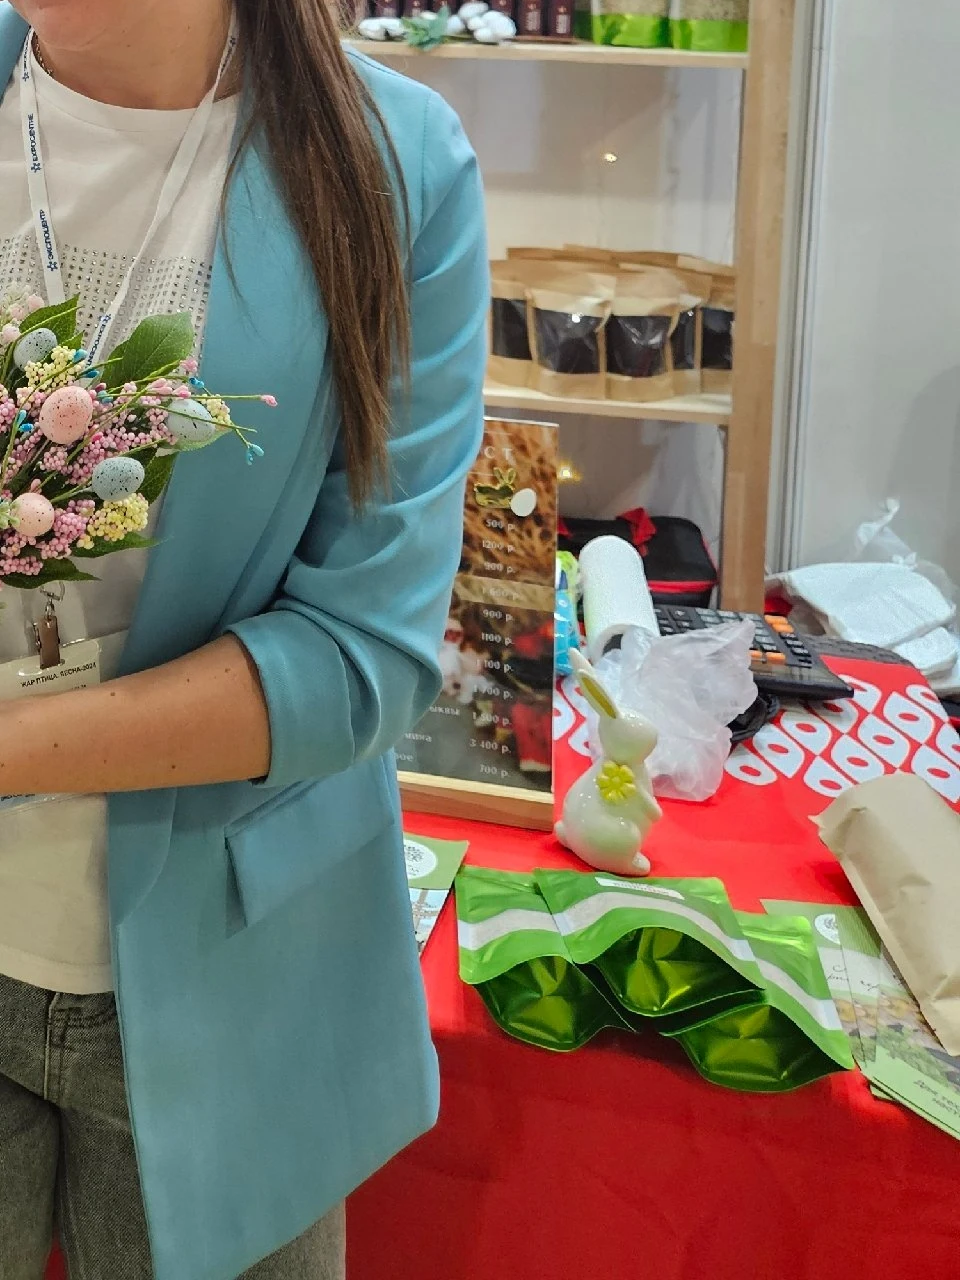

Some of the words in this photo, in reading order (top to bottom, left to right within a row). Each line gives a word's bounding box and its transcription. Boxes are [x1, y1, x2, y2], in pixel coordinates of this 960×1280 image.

[28, 113, 39, 162] EXPOCENTRE
[39, 209, 54, 261] ЭКСПОЦЕНТР
[483, 609, 502, 619] 900
[481, 632, 502, 643] 1100
